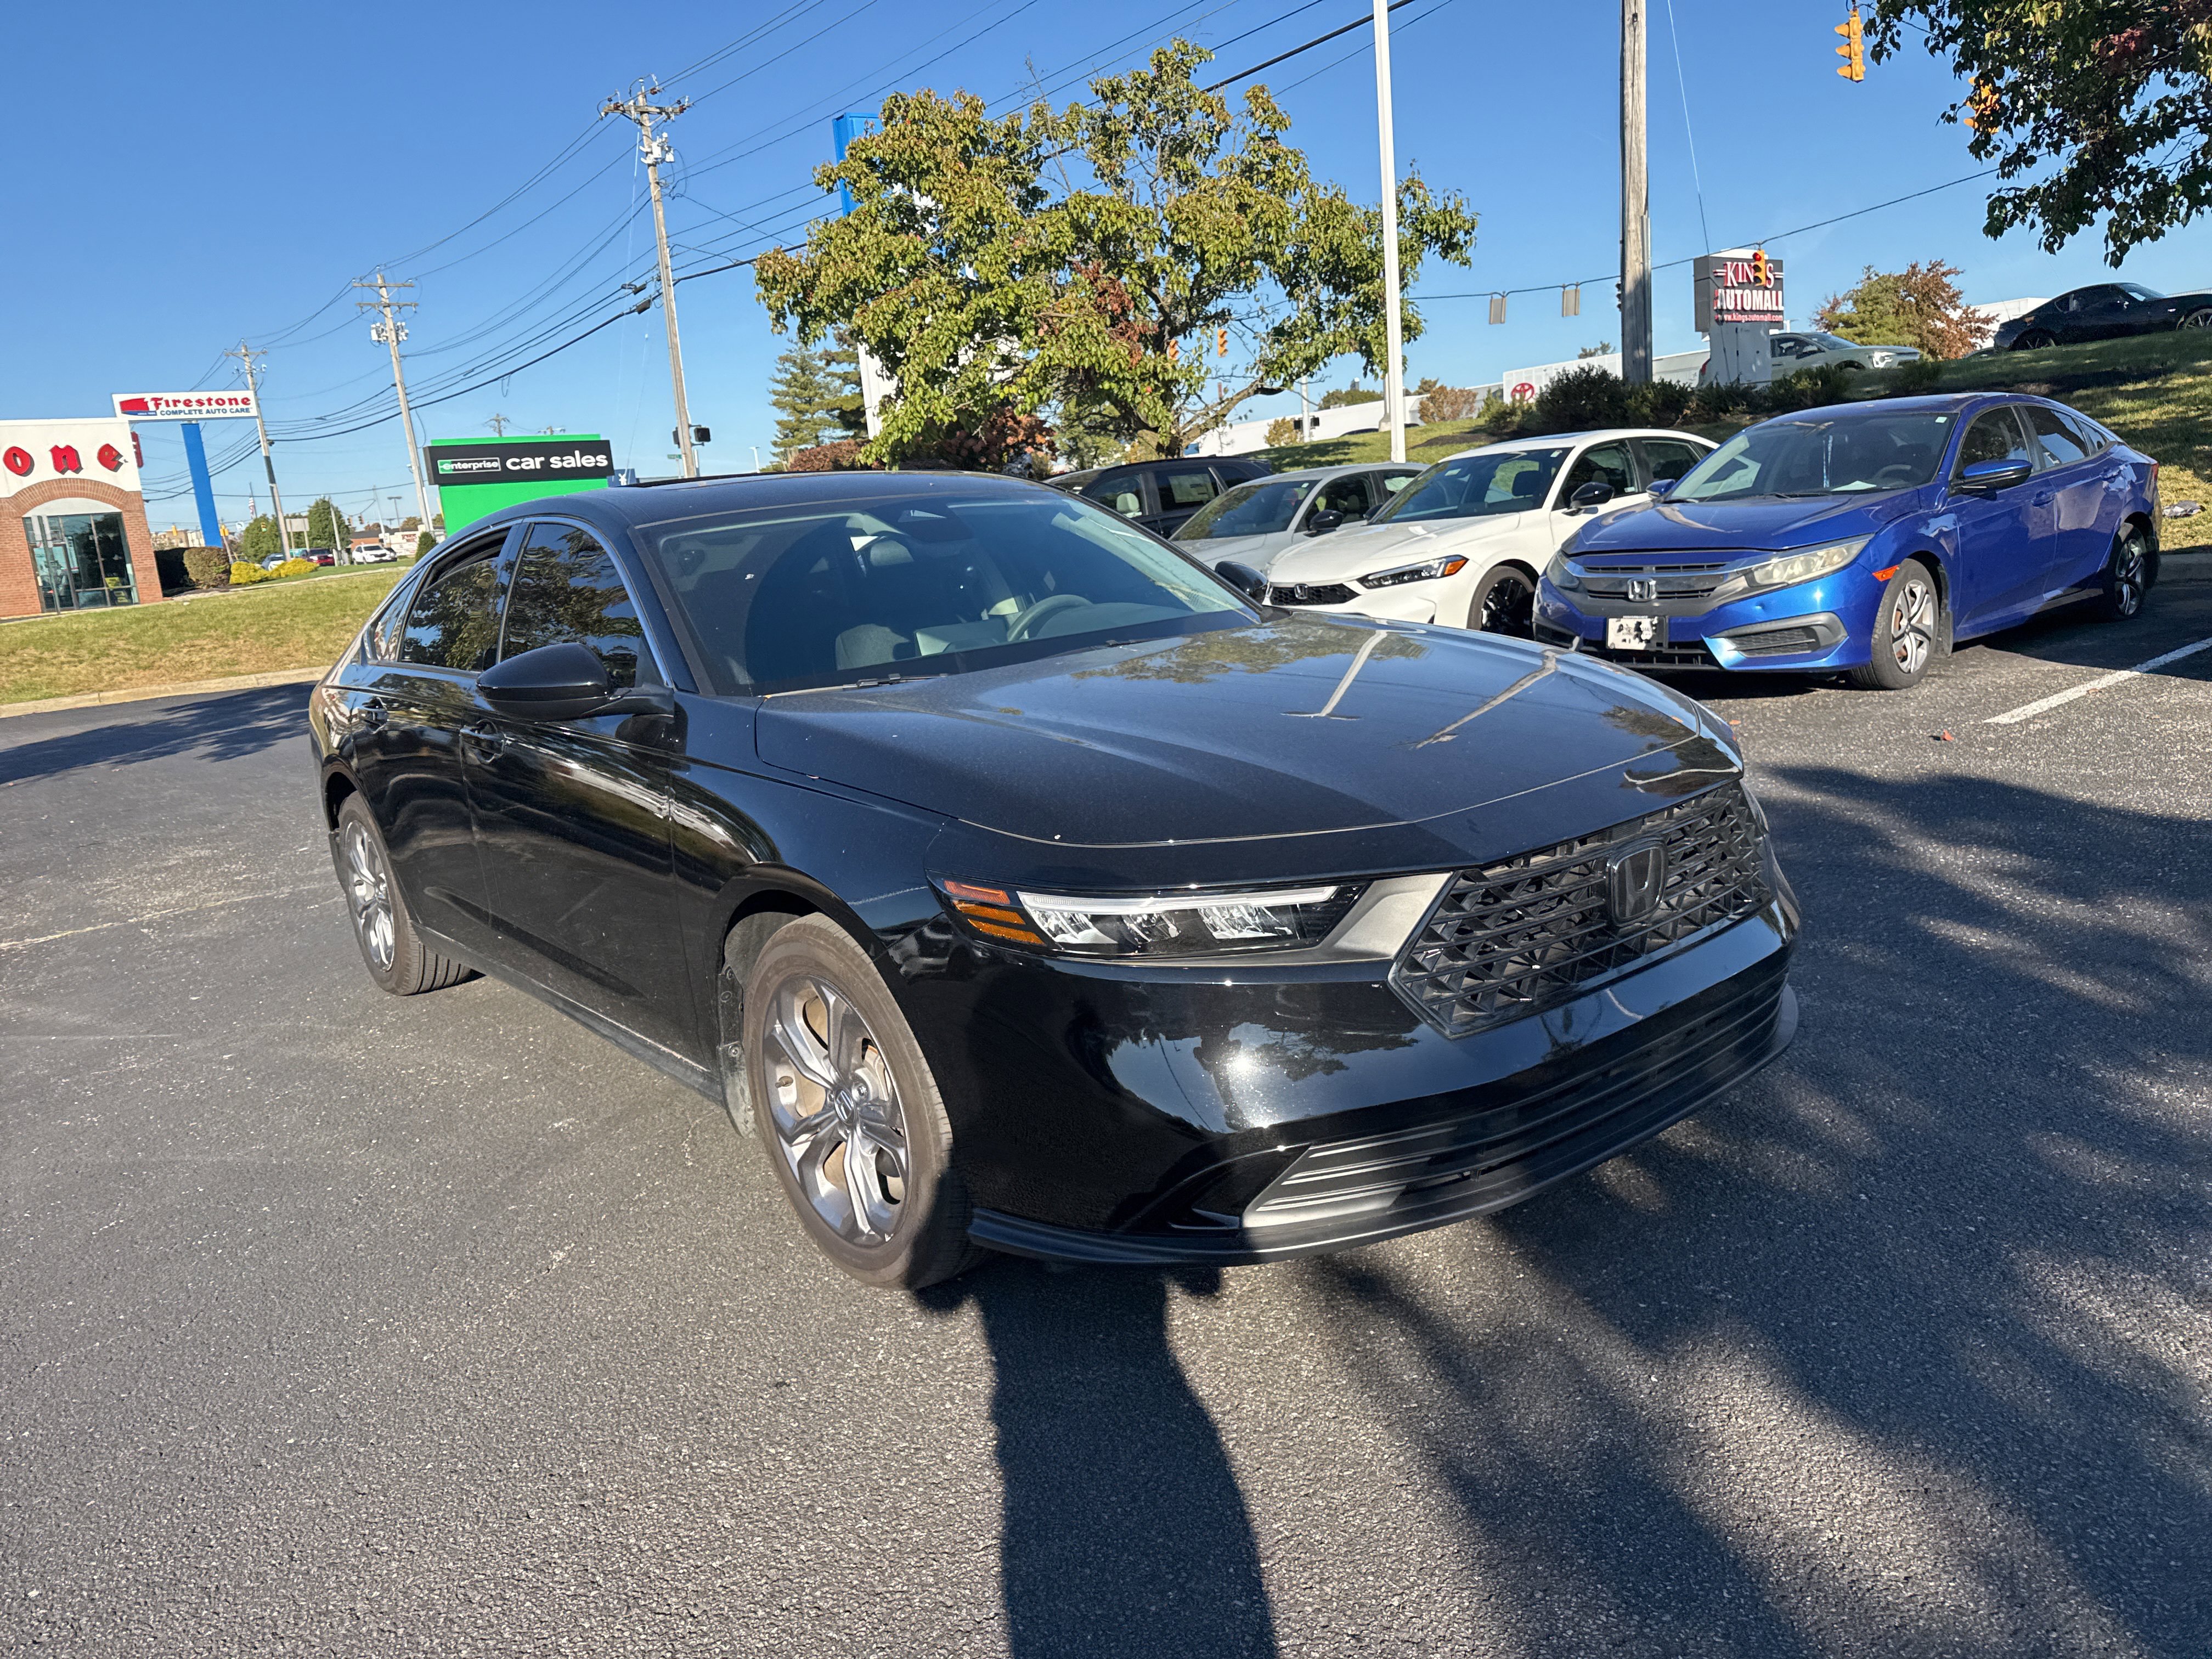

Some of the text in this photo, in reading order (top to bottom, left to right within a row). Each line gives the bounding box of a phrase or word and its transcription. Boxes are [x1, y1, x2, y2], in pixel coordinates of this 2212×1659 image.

[1724, 262, 1774, 288] KINS
[1716, 289, 1784, 311] AUTOMALL
[150, 397, 251, 410] Firestone
[442, 450, 608, 471] enterprise car sales
